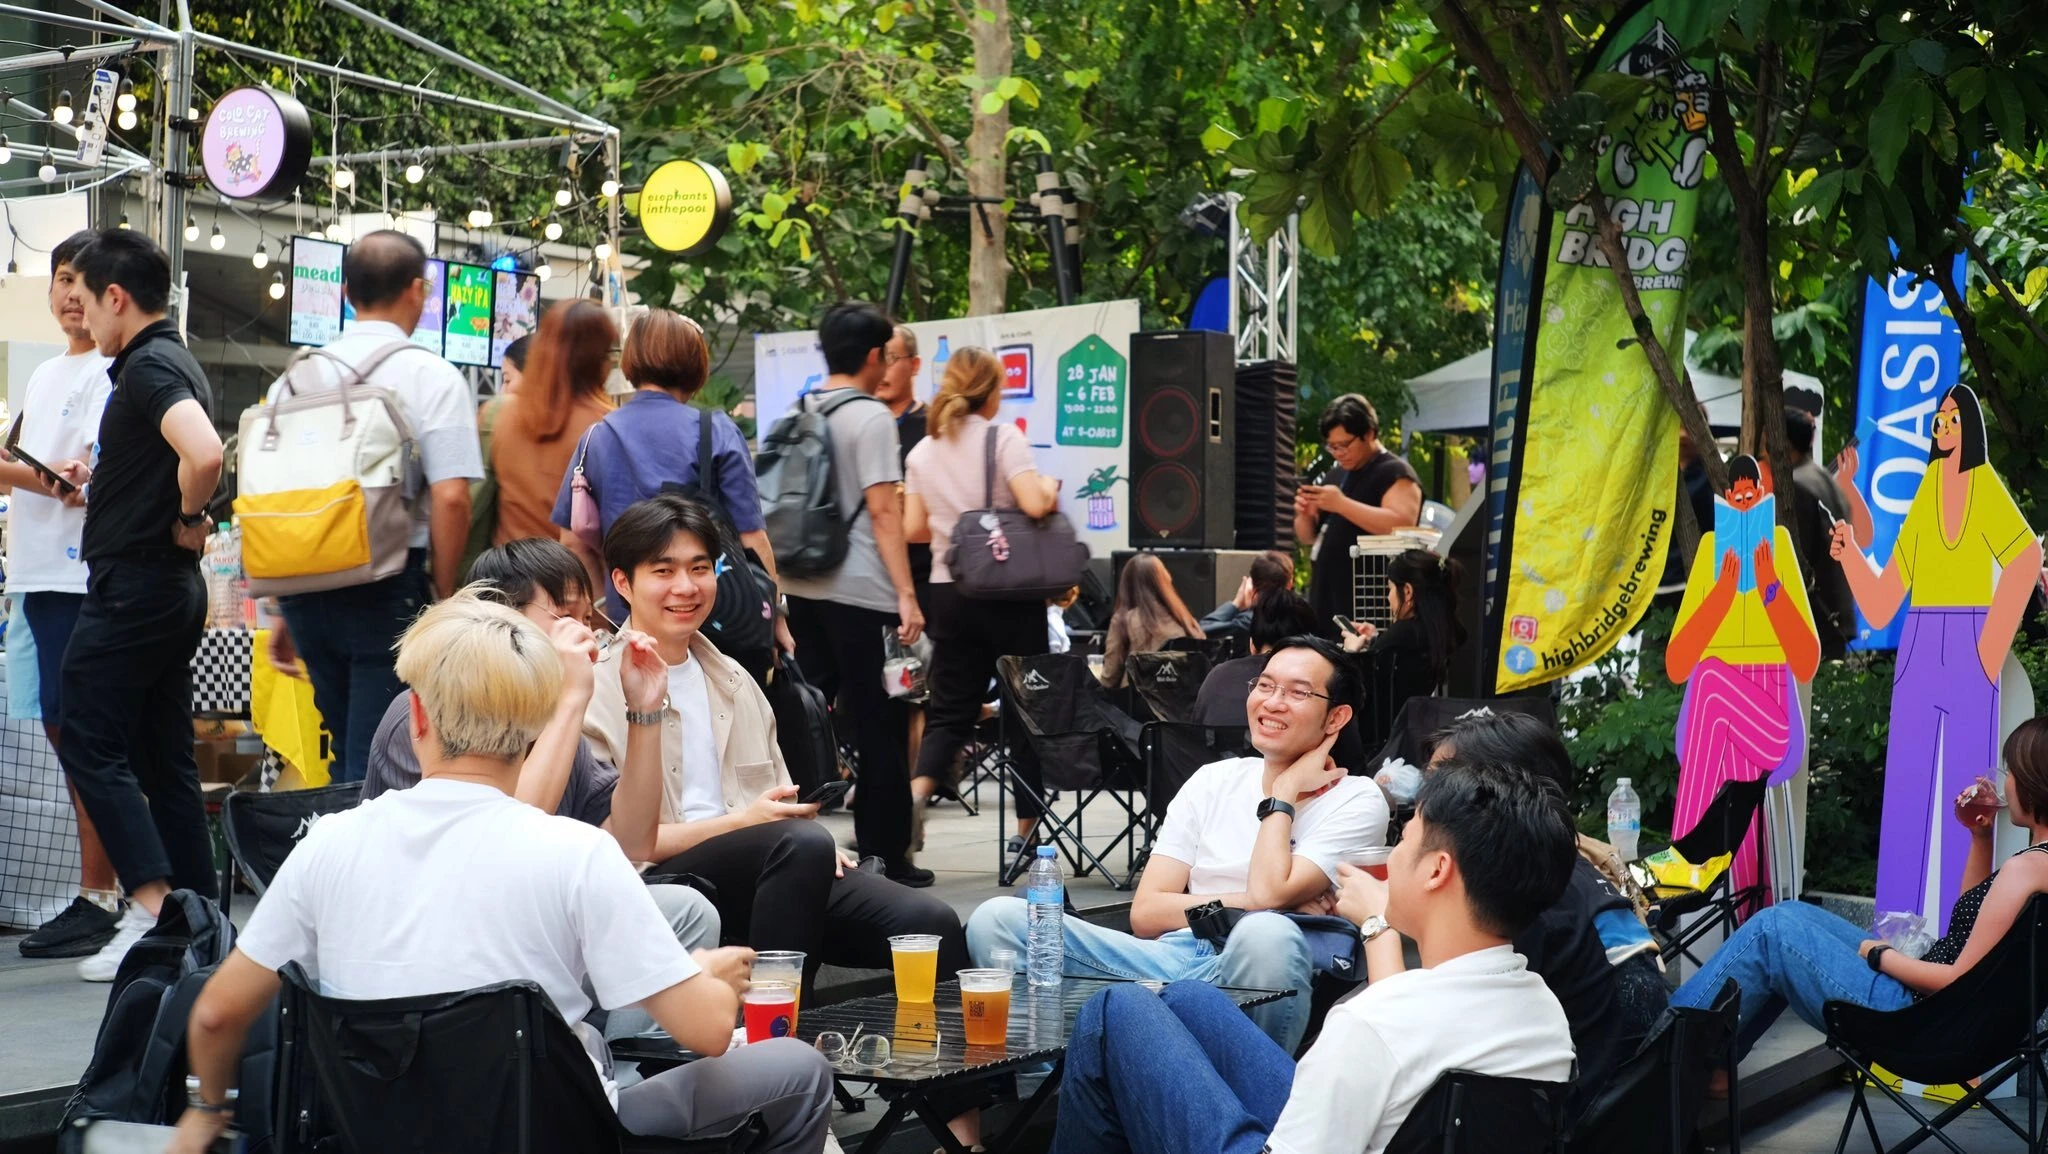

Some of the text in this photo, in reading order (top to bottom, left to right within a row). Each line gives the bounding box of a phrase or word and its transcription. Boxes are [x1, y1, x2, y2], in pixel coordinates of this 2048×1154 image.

[219, 104, 270, 123] COLD CAT
[220, 123, 265, 140] BREWING
[647, 187, 708, 202] elephants
[647, 204, 706, 215] inthepool
[294, 264, 341, 283] mead
[1067, 364, 1117, 384] 28 JAN
[1077, 386, 1087, 401] 6
[1090, 385, 1116, 402] FEB
[1062, 426, 1117, 439] AT S-OASIS
[1541, 508, 1667, 672] highbridgebrewing
